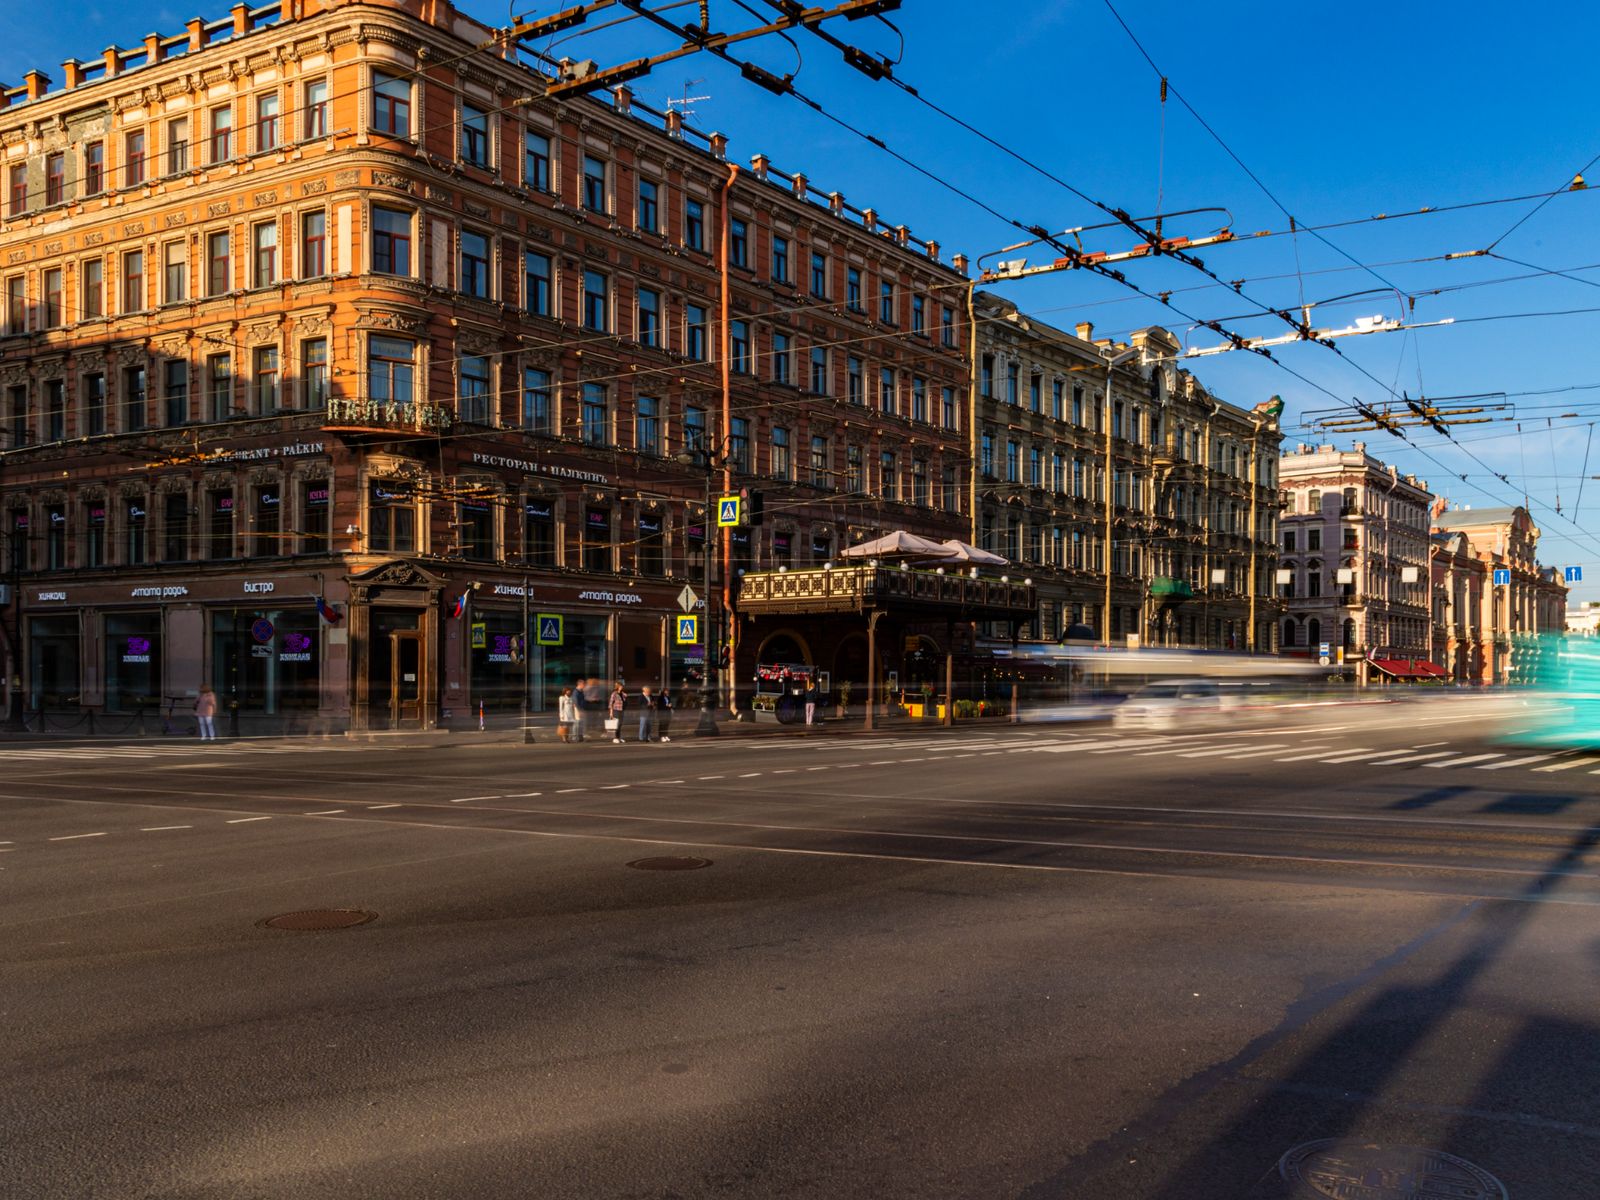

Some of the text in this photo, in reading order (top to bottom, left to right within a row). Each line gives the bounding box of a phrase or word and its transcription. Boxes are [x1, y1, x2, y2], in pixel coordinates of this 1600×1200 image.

[283, 442, 324, 456] PALKIN
[472, 453, 608, 484] РЕСТОРАН ПАЛКИНЪ
[244, 581, 274, 593] бистро
[494, 585, 534, 596] хинкаи
